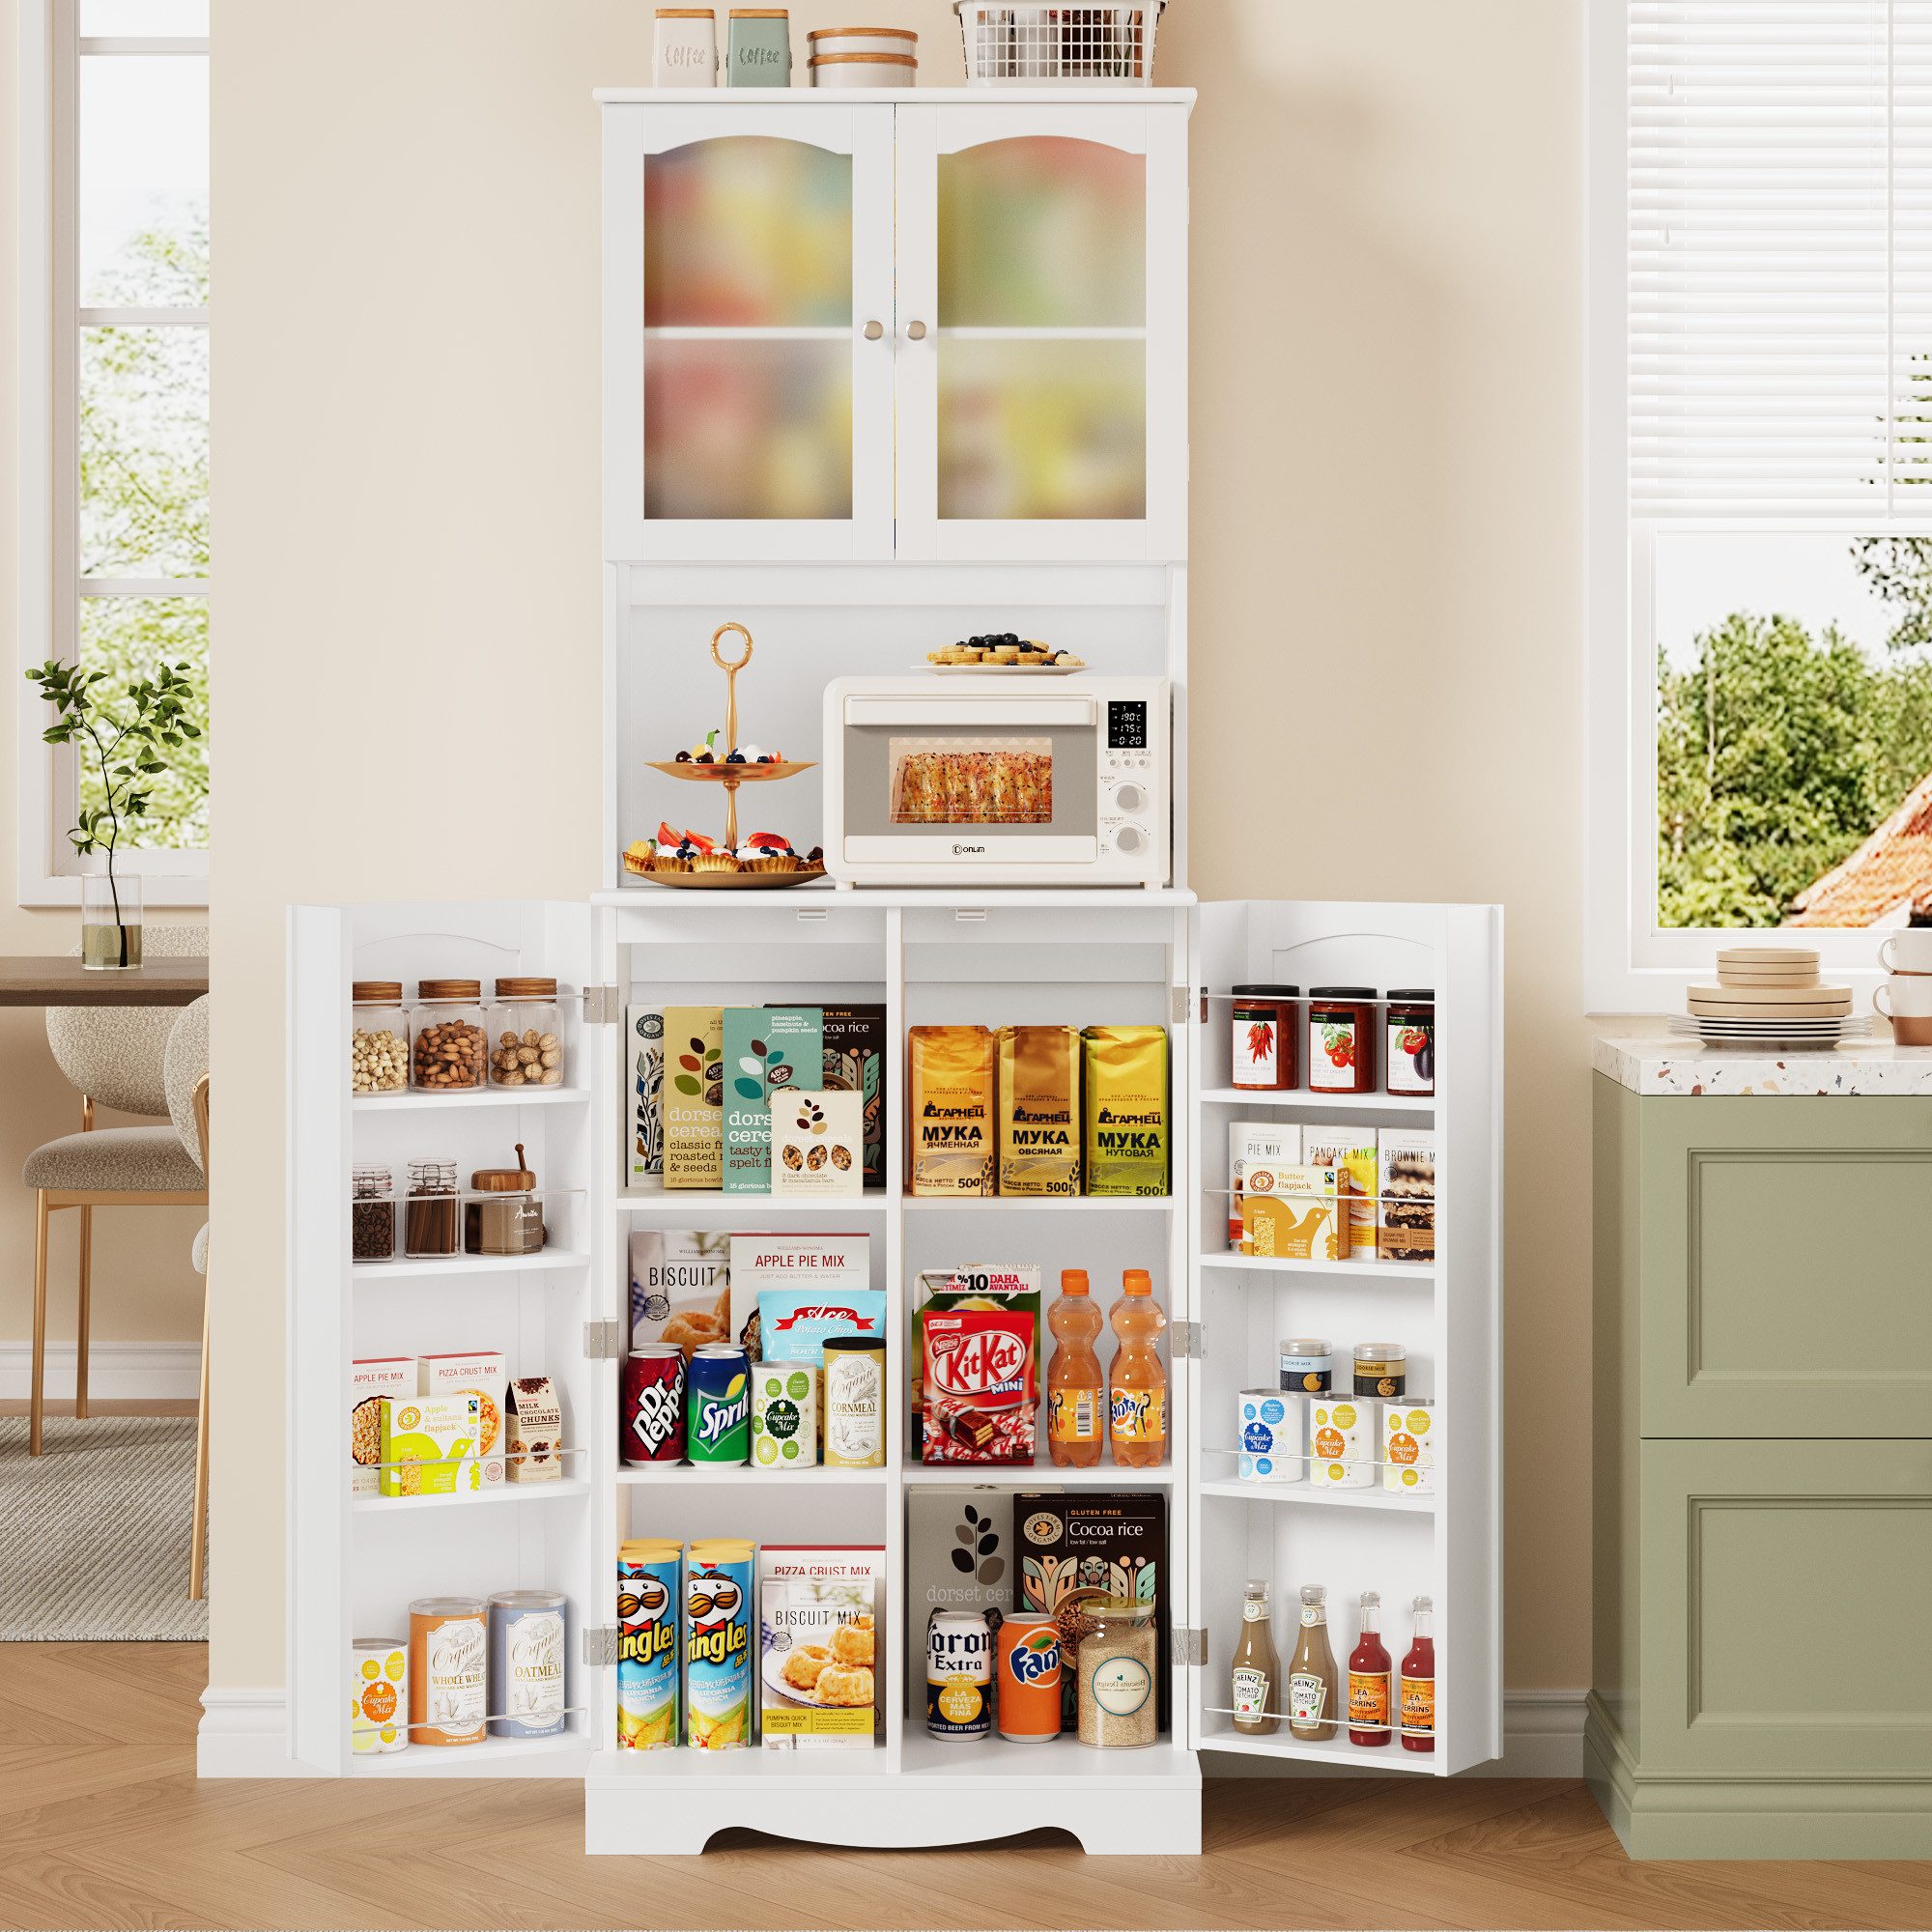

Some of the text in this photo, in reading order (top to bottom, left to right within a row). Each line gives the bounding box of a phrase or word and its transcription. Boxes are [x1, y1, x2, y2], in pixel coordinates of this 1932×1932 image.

[665, 45, 706, 69] Coffee
[738, 46, 780, 66] Coffee
[848, 1021, 869, 1033] rice
[728, 1111, 772, 1125] dors
[669, 1125, 723, 1138] cerea
[728, 1130, 772, 1143] cere
[923, 1125, 982, 1141] МУКА
[1012, 1129, 1069, 1145] МУКА
[669, 1141, 711, 1150] classic
[1097, 1132, 1161, 1149] МУКА
[729, 1146, 763, 1156] tasty
[1247, 1143, 1281, 1156] PIE MIX
[1310, 1146, 1369, 1160] PANCAKE MIX
[669, 1151, 715, 1161] roasted
[1384, 1150, 1425, 1163] BROWNIE
[669, 1163, 717, 1172] & seeds
[729, 1158, 762, 1170] spelt
[1278, 1172, 1305, 1180] Butter
[1278, 1180, 1312, 1190] flapjack
[754, 1255, 845, 1267] APPLE PIE MIX
[649, 1266, 716, 1287] BISCUIT
[957, 1273, 989, 1291] %10
[989, 1274, 1020, 1284] DAHA
[797, 1301, 853, 1321] Ace
[795, 1324, 854, 1335] Potato Chips
[947, 1335, 1017, 1390] KitKat
[354, 1372, 404, 1382] APPLE PIE MIX
[439, 1365, 497, 1378] PIZZA CRUST MIX
[639, 1378, 668, 1419] Dr
[425, 1405, 448, 1414] Apple
[520, 1407, 559, 1416] CHOCOLATE
[831, 1402, 876, 1413] CORNMEAL
[520, 1414, 560, 1424] CHUNKS
[766, 1410, 798, 1424] Cupcake
[425, 1423, 457, 1433] flapjack
[775, 1421, 795, 1432] Mix
[1244, 1432, 1270, 1443] Cupcake
[1316, 1436, 1343, 1448] Cupcake
[1250, 1440, 1267, 1451] Mix
[1321, 1446, 1339, 1457] Mix
[1390, 1443, 1417, 1454] Cupcake
[1396, 1451, 1413, 1462] Mix
[1025, 1514, 1061, 1530] DOVES FARM
[1069, 1521, 1144, 1536] Cocoa rice
[1028, 1531, 1060, 1544] ORGANIC
[774, 1566, 871, 1576] PIZZA CRUST MIX
[926, 1585, 981, 1603] dorset
[776, 1610, 861, 1626] BISCUIT MIX
[935, 1655, 982, 1671] Extra
[432, 1675, 464, 1685] WHOLE
[1236, 1674, 1257, 1684] HEINZ
[1294, 1680, 1315, 1690] HEINZ
[363, 1694, 395, 1707] Cupcake
[373, 1704, 392, 1716] Mix
